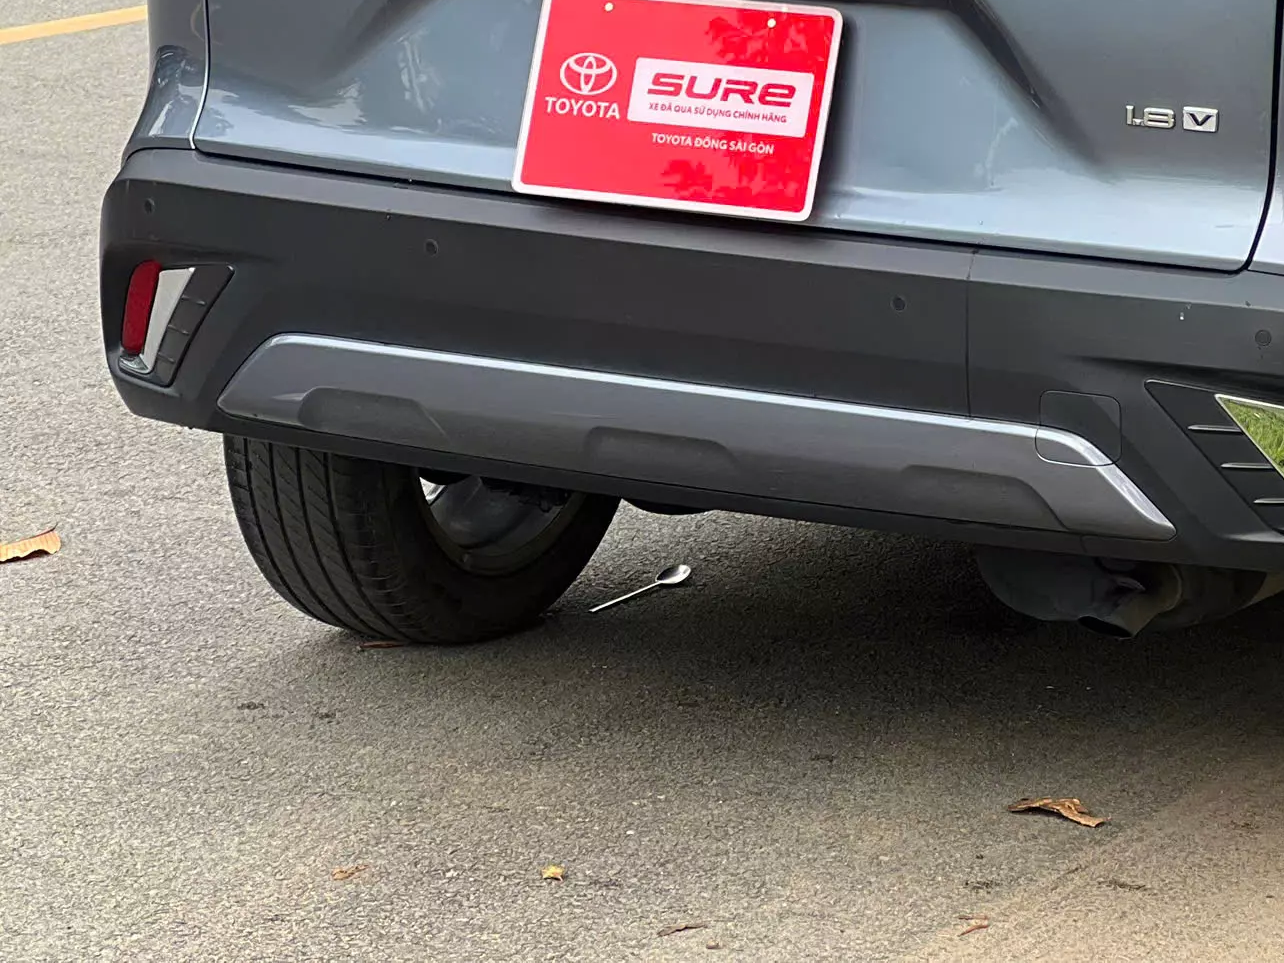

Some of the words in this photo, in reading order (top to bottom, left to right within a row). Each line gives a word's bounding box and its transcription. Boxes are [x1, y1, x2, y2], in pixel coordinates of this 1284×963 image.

[544, 96, 621, 120] TOYOTA
[649, 102, 659, 111] XE
[674, 105, 692, 115] QUA
[1125, 104, 1175, 129] 1.8
[651, 132, 692, 147] TOYOTA
[693, 135, 728, 150] ĐÔNG
[729, 138, 747, 152] SÀI
[749, 141, 775, 155] GÒN
